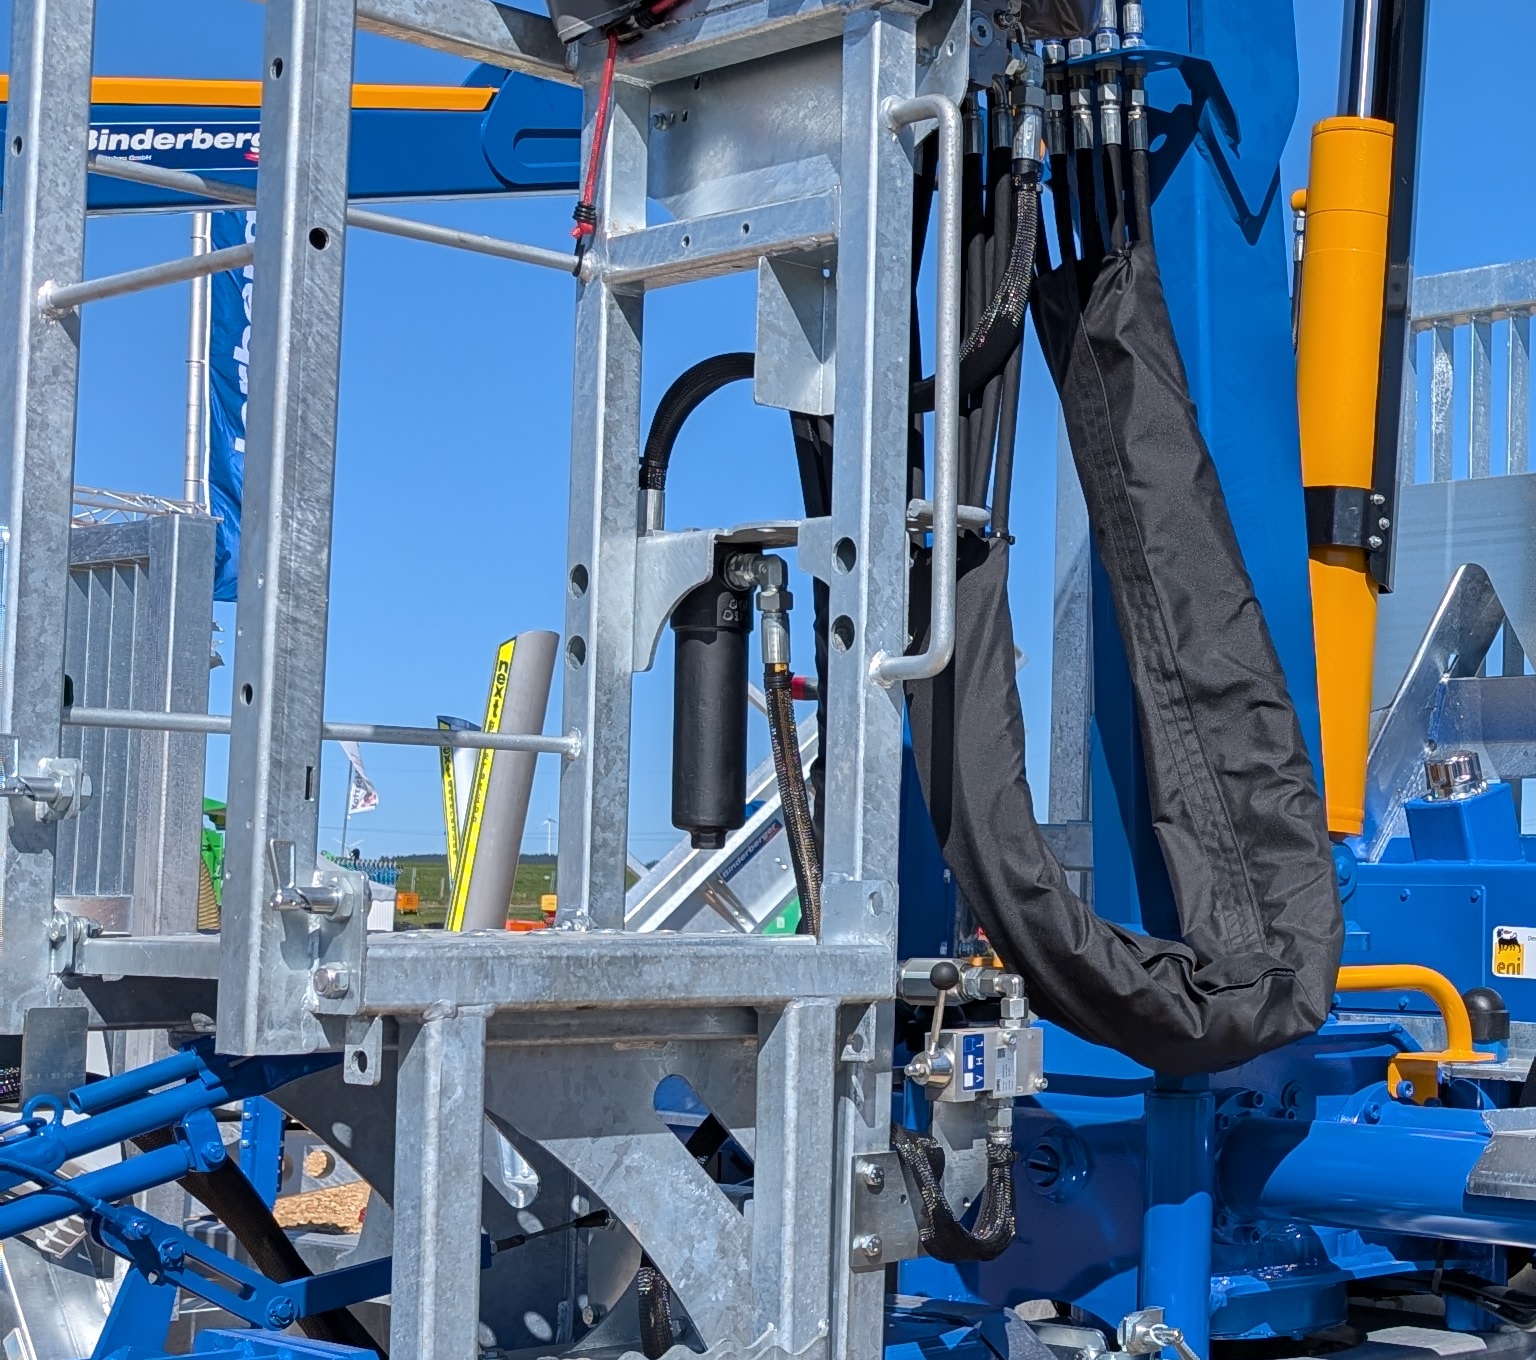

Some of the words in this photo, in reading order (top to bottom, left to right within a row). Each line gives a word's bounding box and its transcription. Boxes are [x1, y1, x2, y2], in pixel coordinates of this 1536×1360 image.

[88, 128, 261, 153] inderberg
[492, 660, 509, 719] next
[1496, 957, 1521, 975] eni
